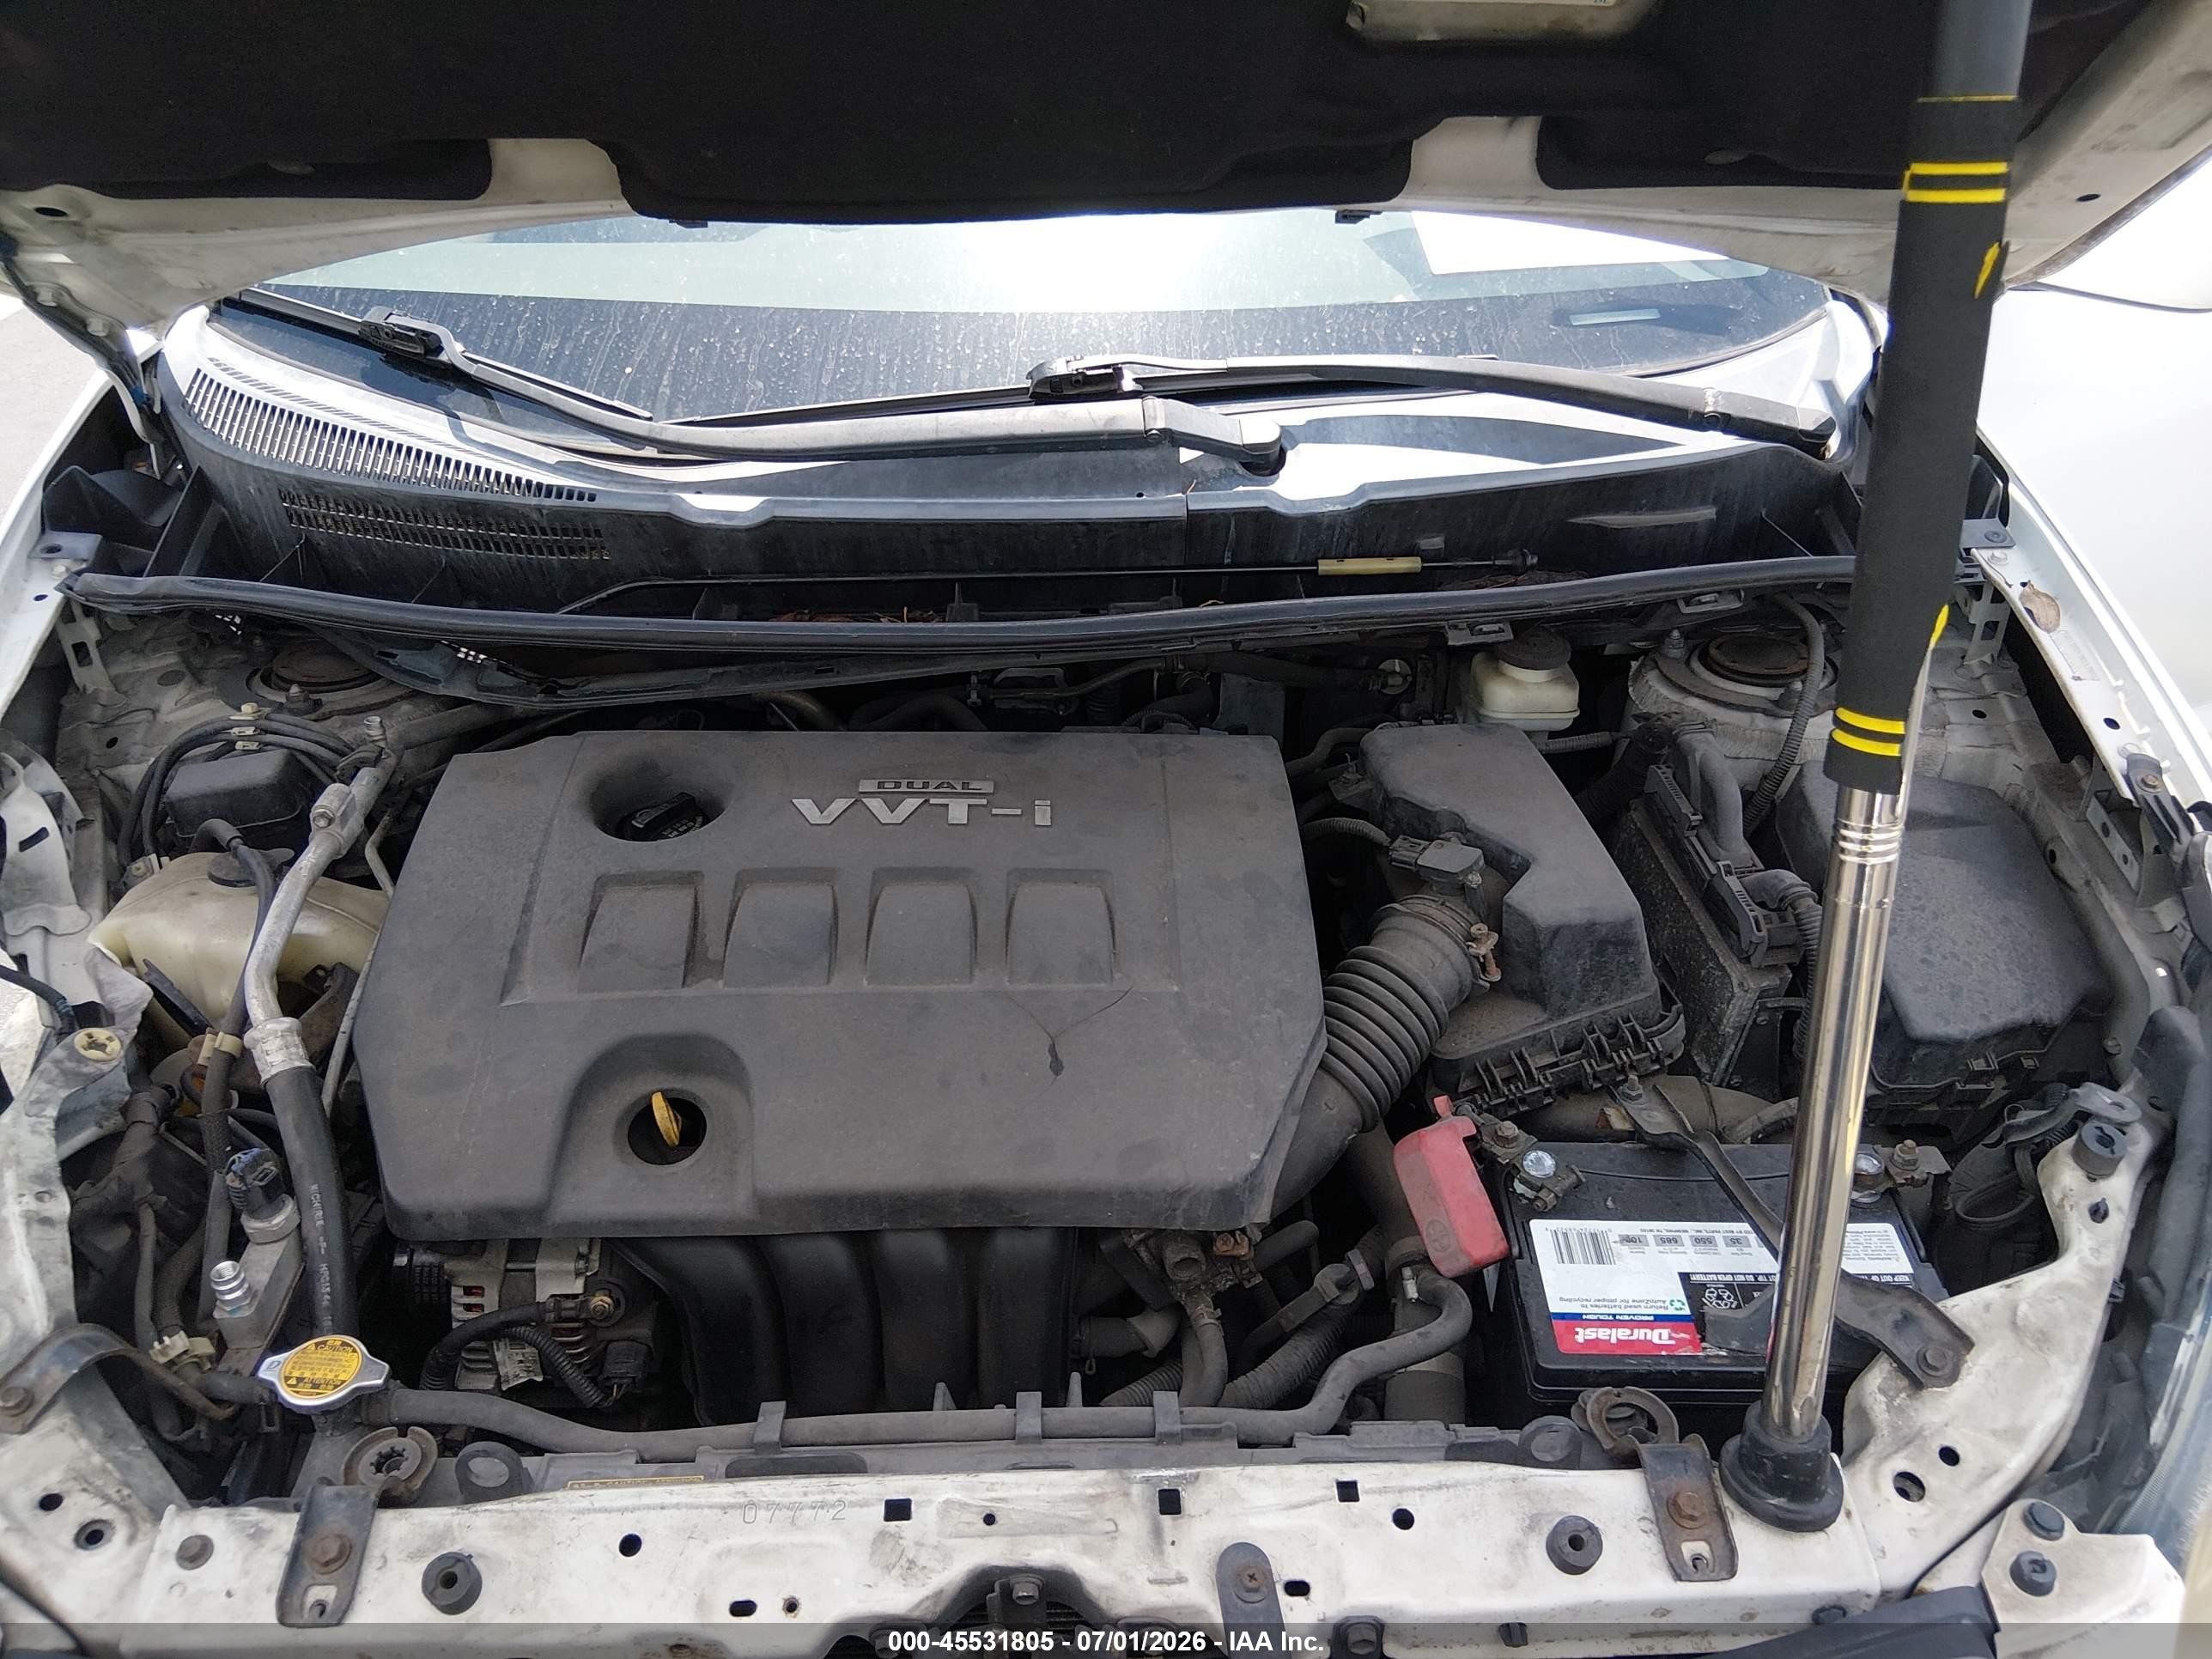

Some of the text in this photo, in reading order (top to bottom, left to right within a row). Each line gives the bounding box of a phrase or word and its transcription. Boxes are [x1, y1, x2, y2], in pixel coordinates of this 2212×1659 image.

[877, 780, 983, 791] DUAL
[790, 797, 1052, 826] VVT-i
[1574, 1327, 1676, 1346] Duralast
[317, 1344, 354, 1352] CAUTION
[743, 1499, 847, 1524] 07772
